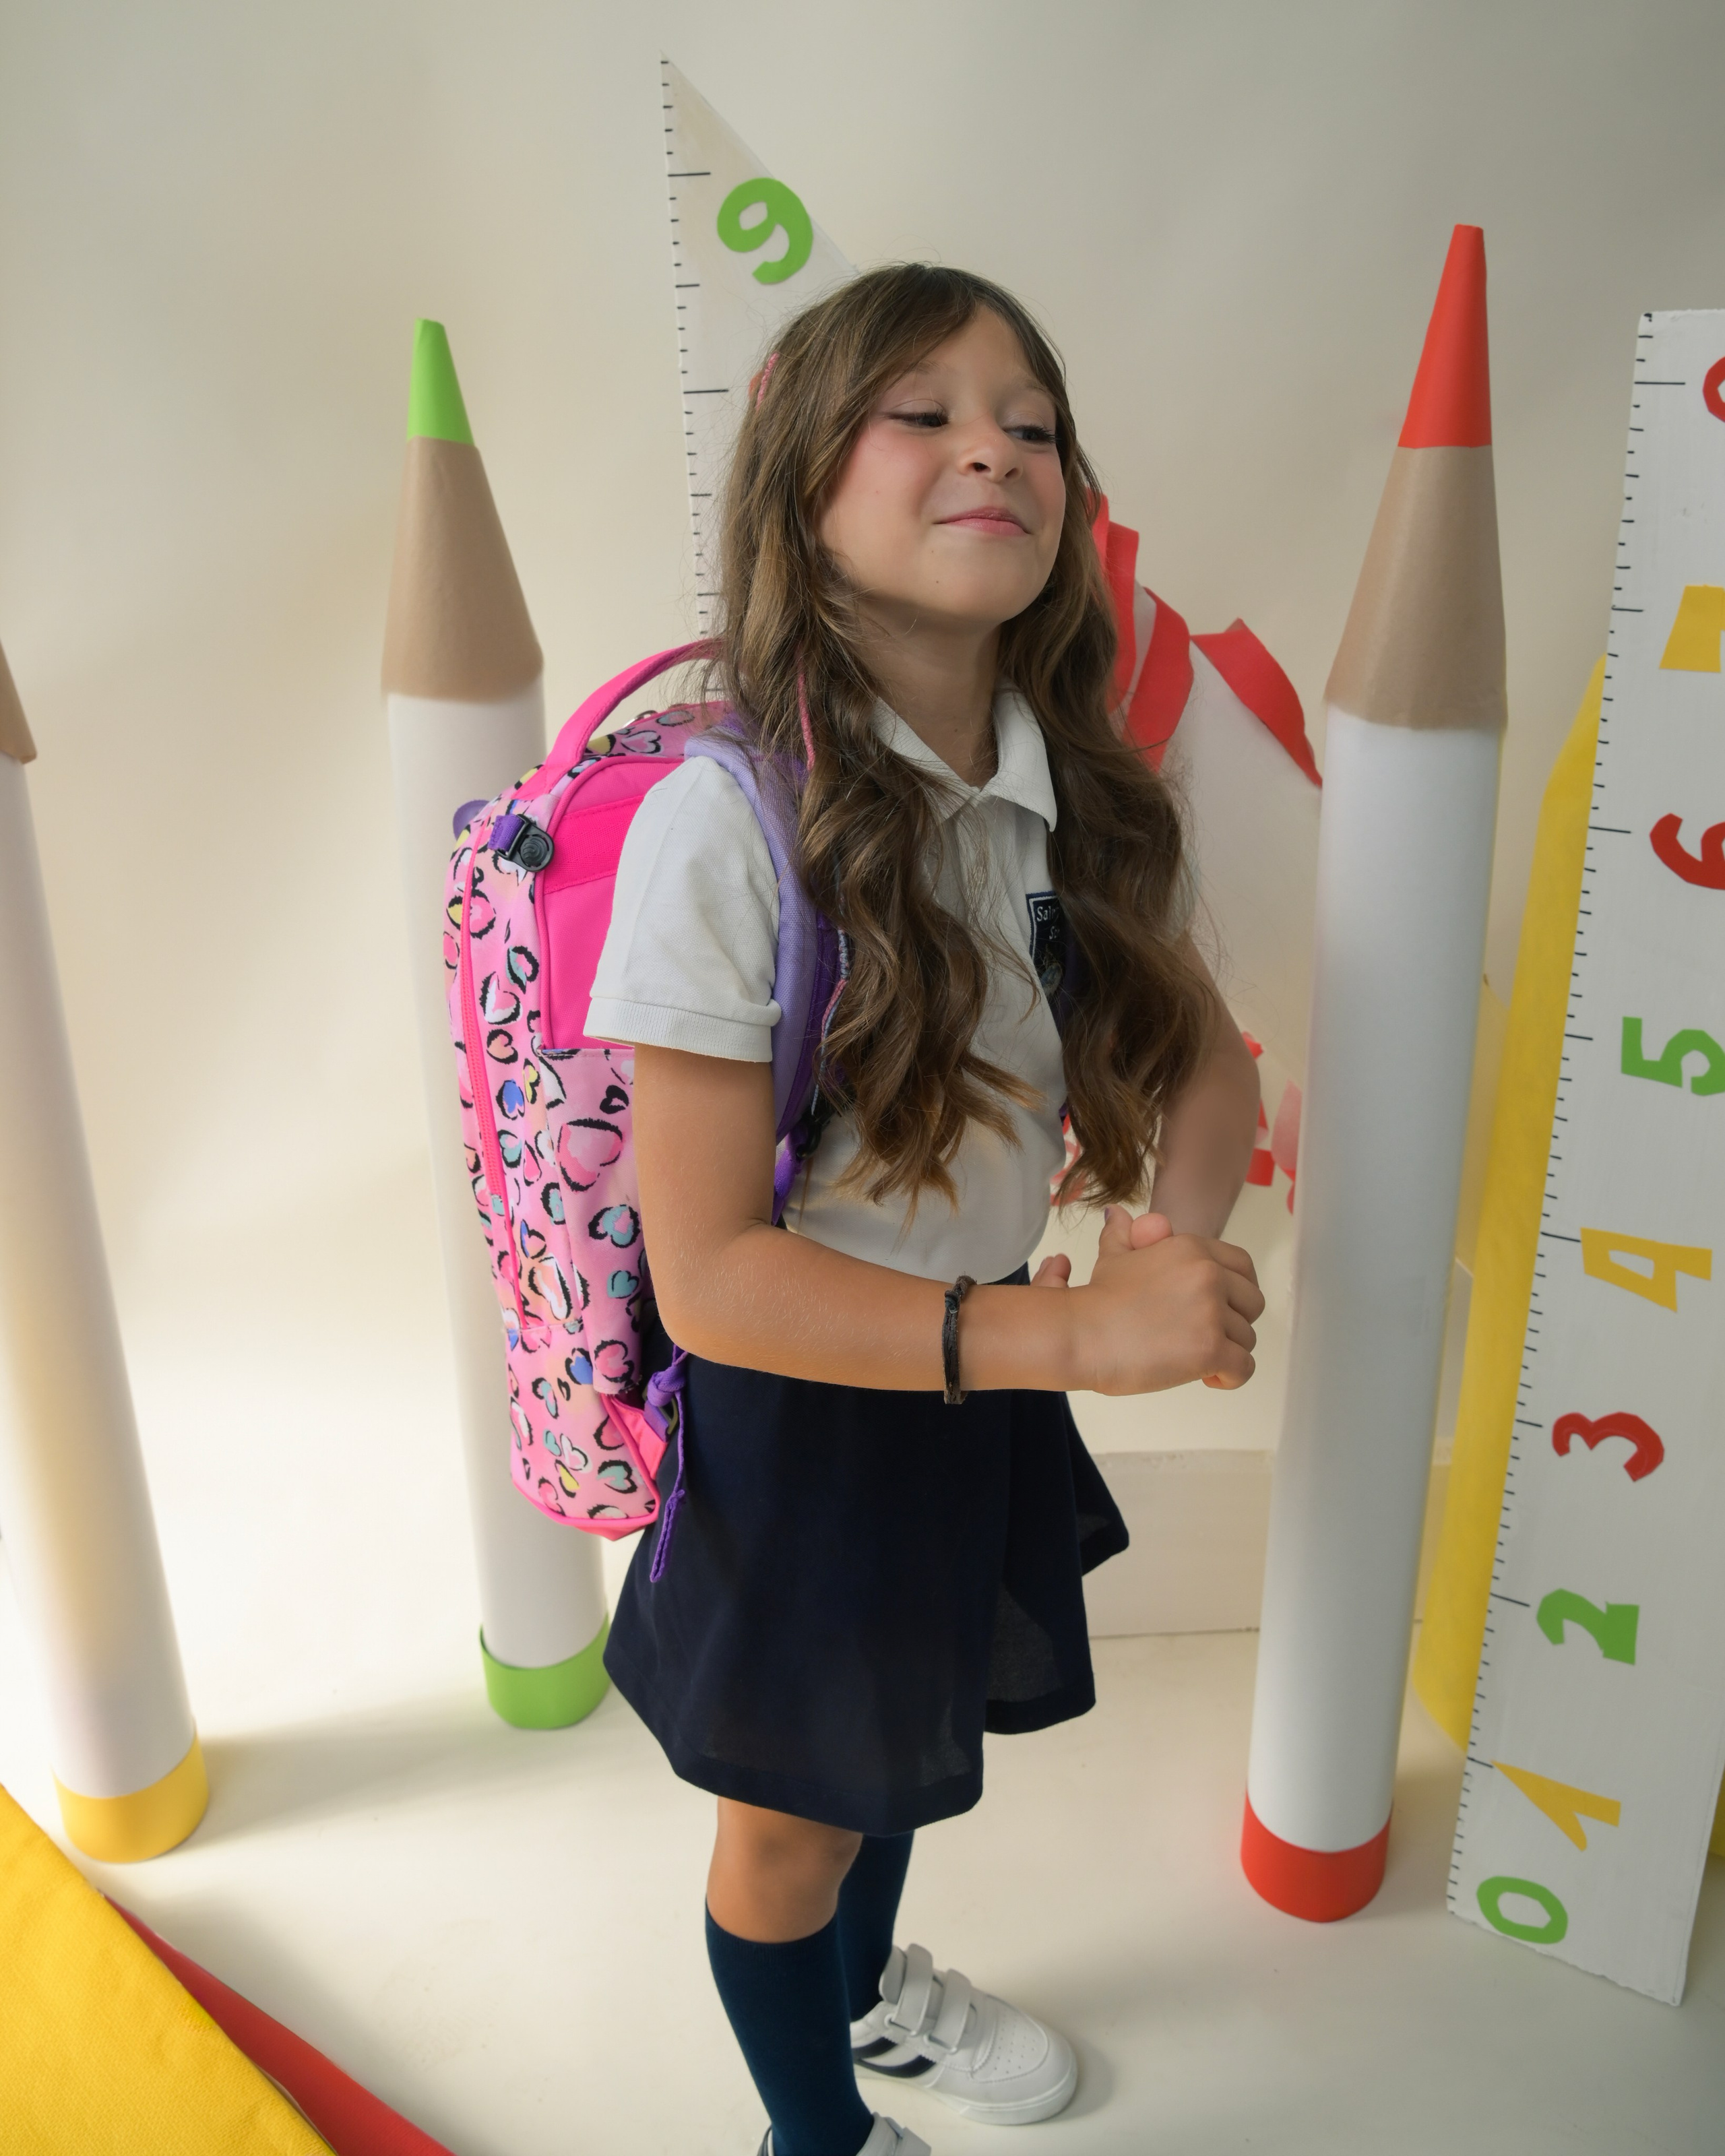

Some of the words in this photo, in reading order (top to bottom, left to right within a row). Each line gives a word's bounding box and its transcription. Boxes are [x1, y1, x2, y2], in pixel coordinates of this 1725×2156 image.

[716, 177, 814, 284] 9
[1650, 813, 1725, 891] 6
[1621, 1016, 1725, 1096] 5
[1580, 1227, 1713, 1313] 4
[1552, 1412, 1665, 1482] 3
[1536, 1588, 1639, 1665] 2
[1491, 1760, 1621, 1851] 1
[1476, 1876, 1568, 1944] 0
